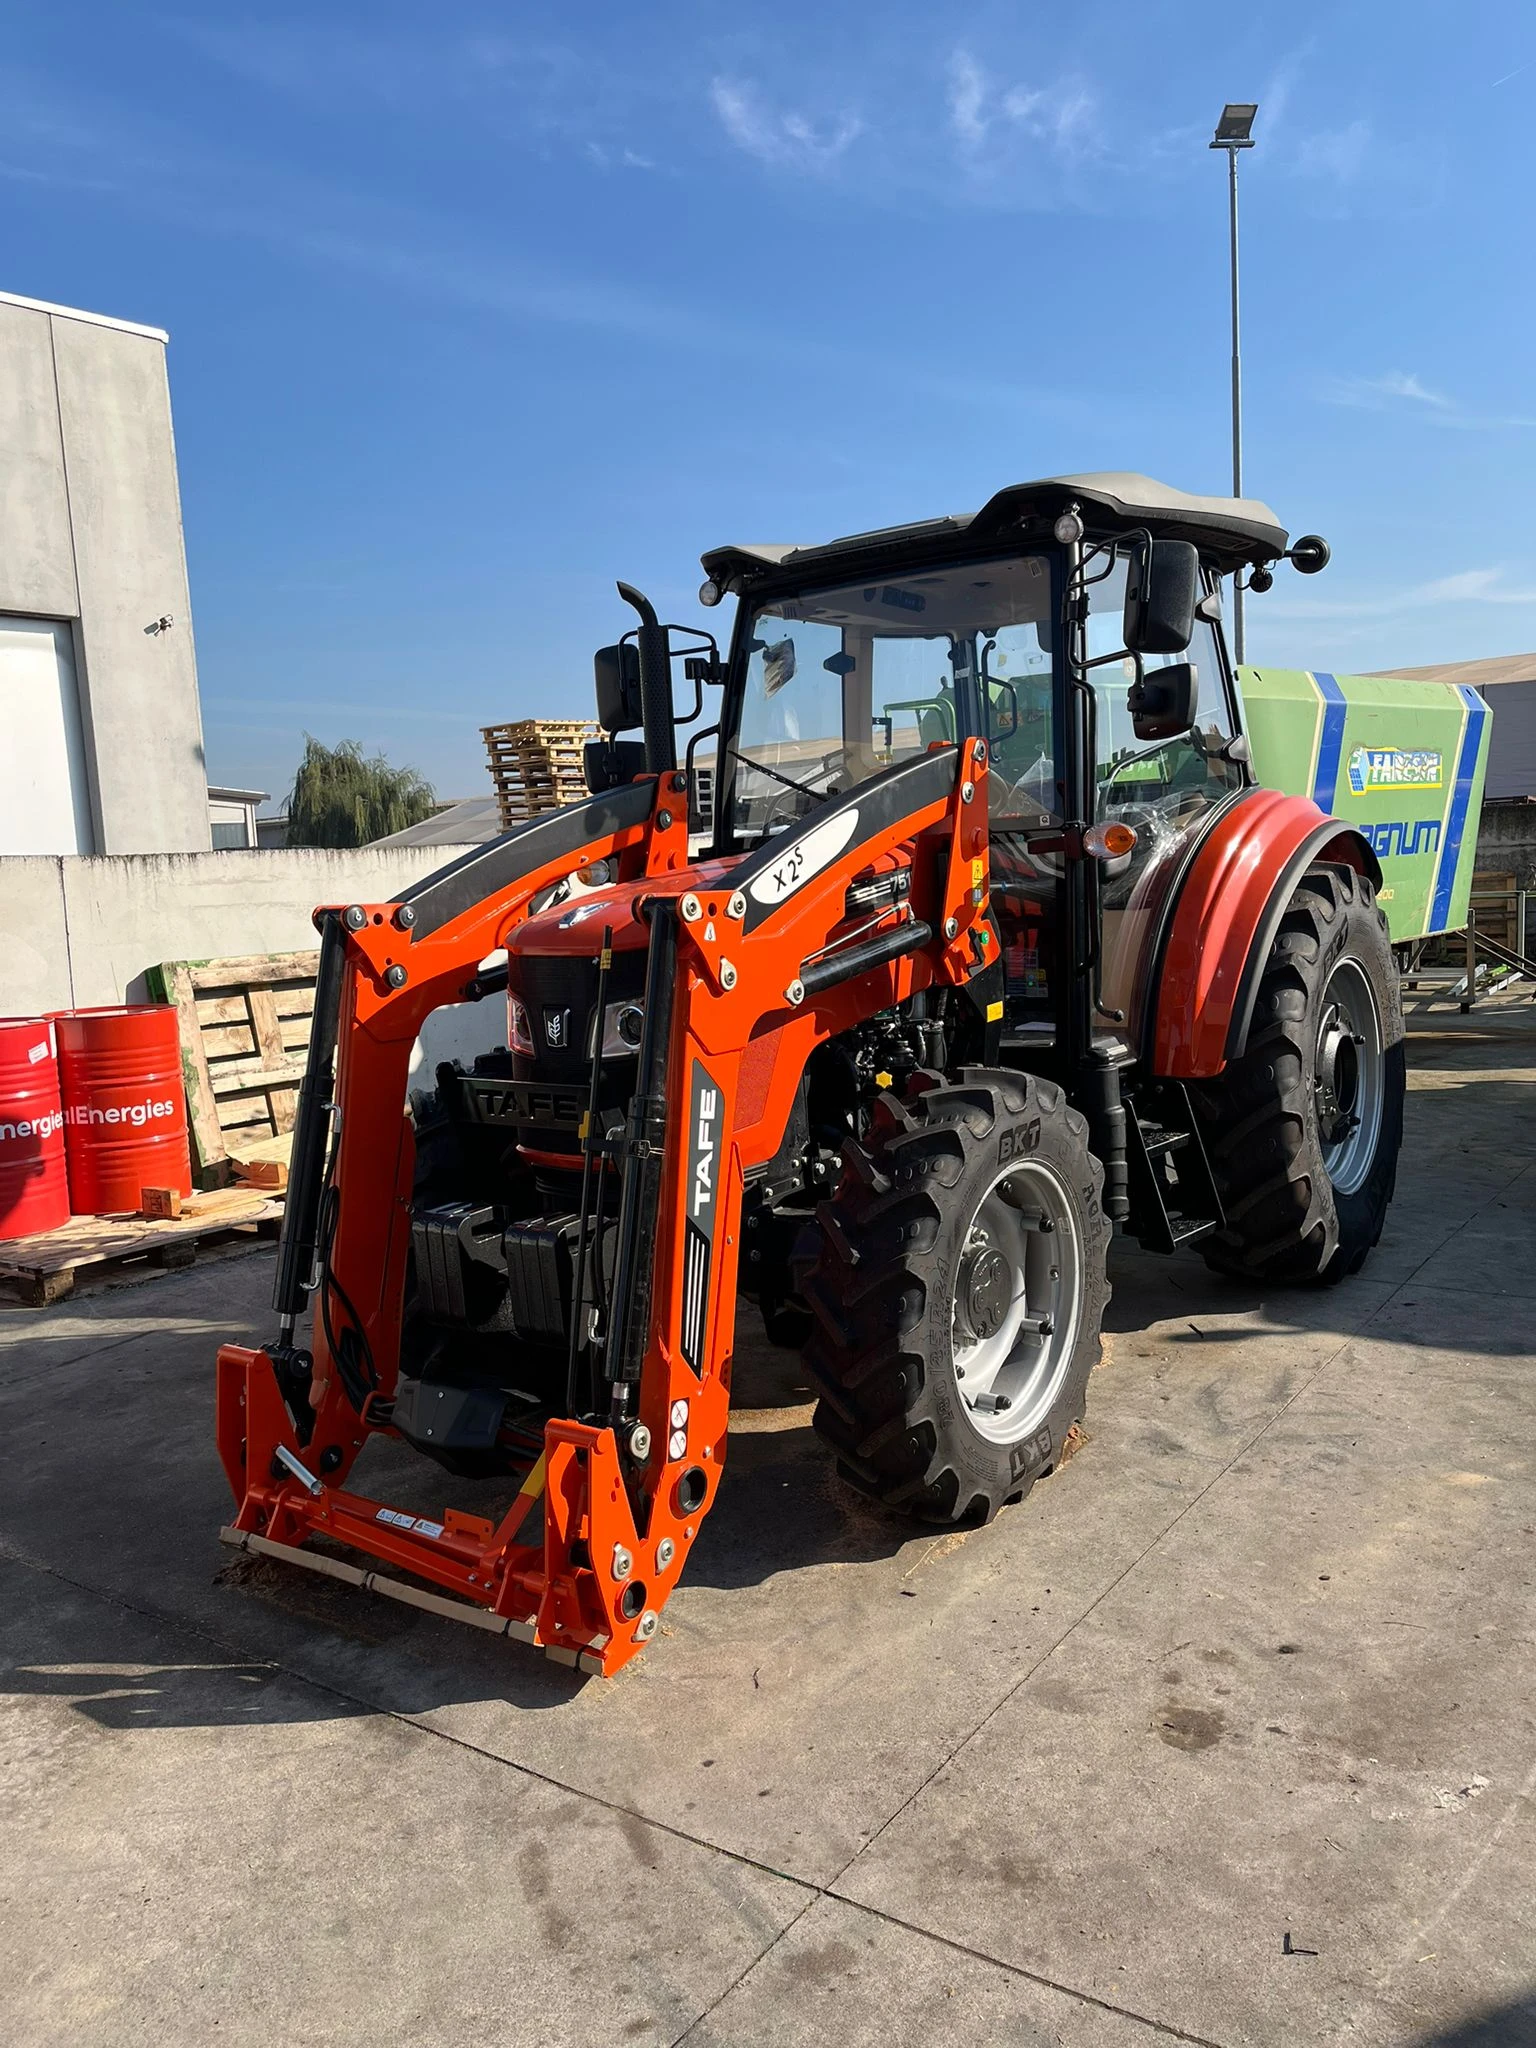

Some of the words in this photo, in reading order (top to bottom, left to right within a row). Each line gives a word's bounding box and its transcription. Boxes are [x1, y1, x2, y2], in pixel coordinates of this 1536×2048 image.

[476, 1089, 579, 1121] TAFE
[694, 1089, 717, 1217] TAFE
[998, 1118, 1040, 1164] BKT
[1009, 1425, 1052, 1485] BKT
